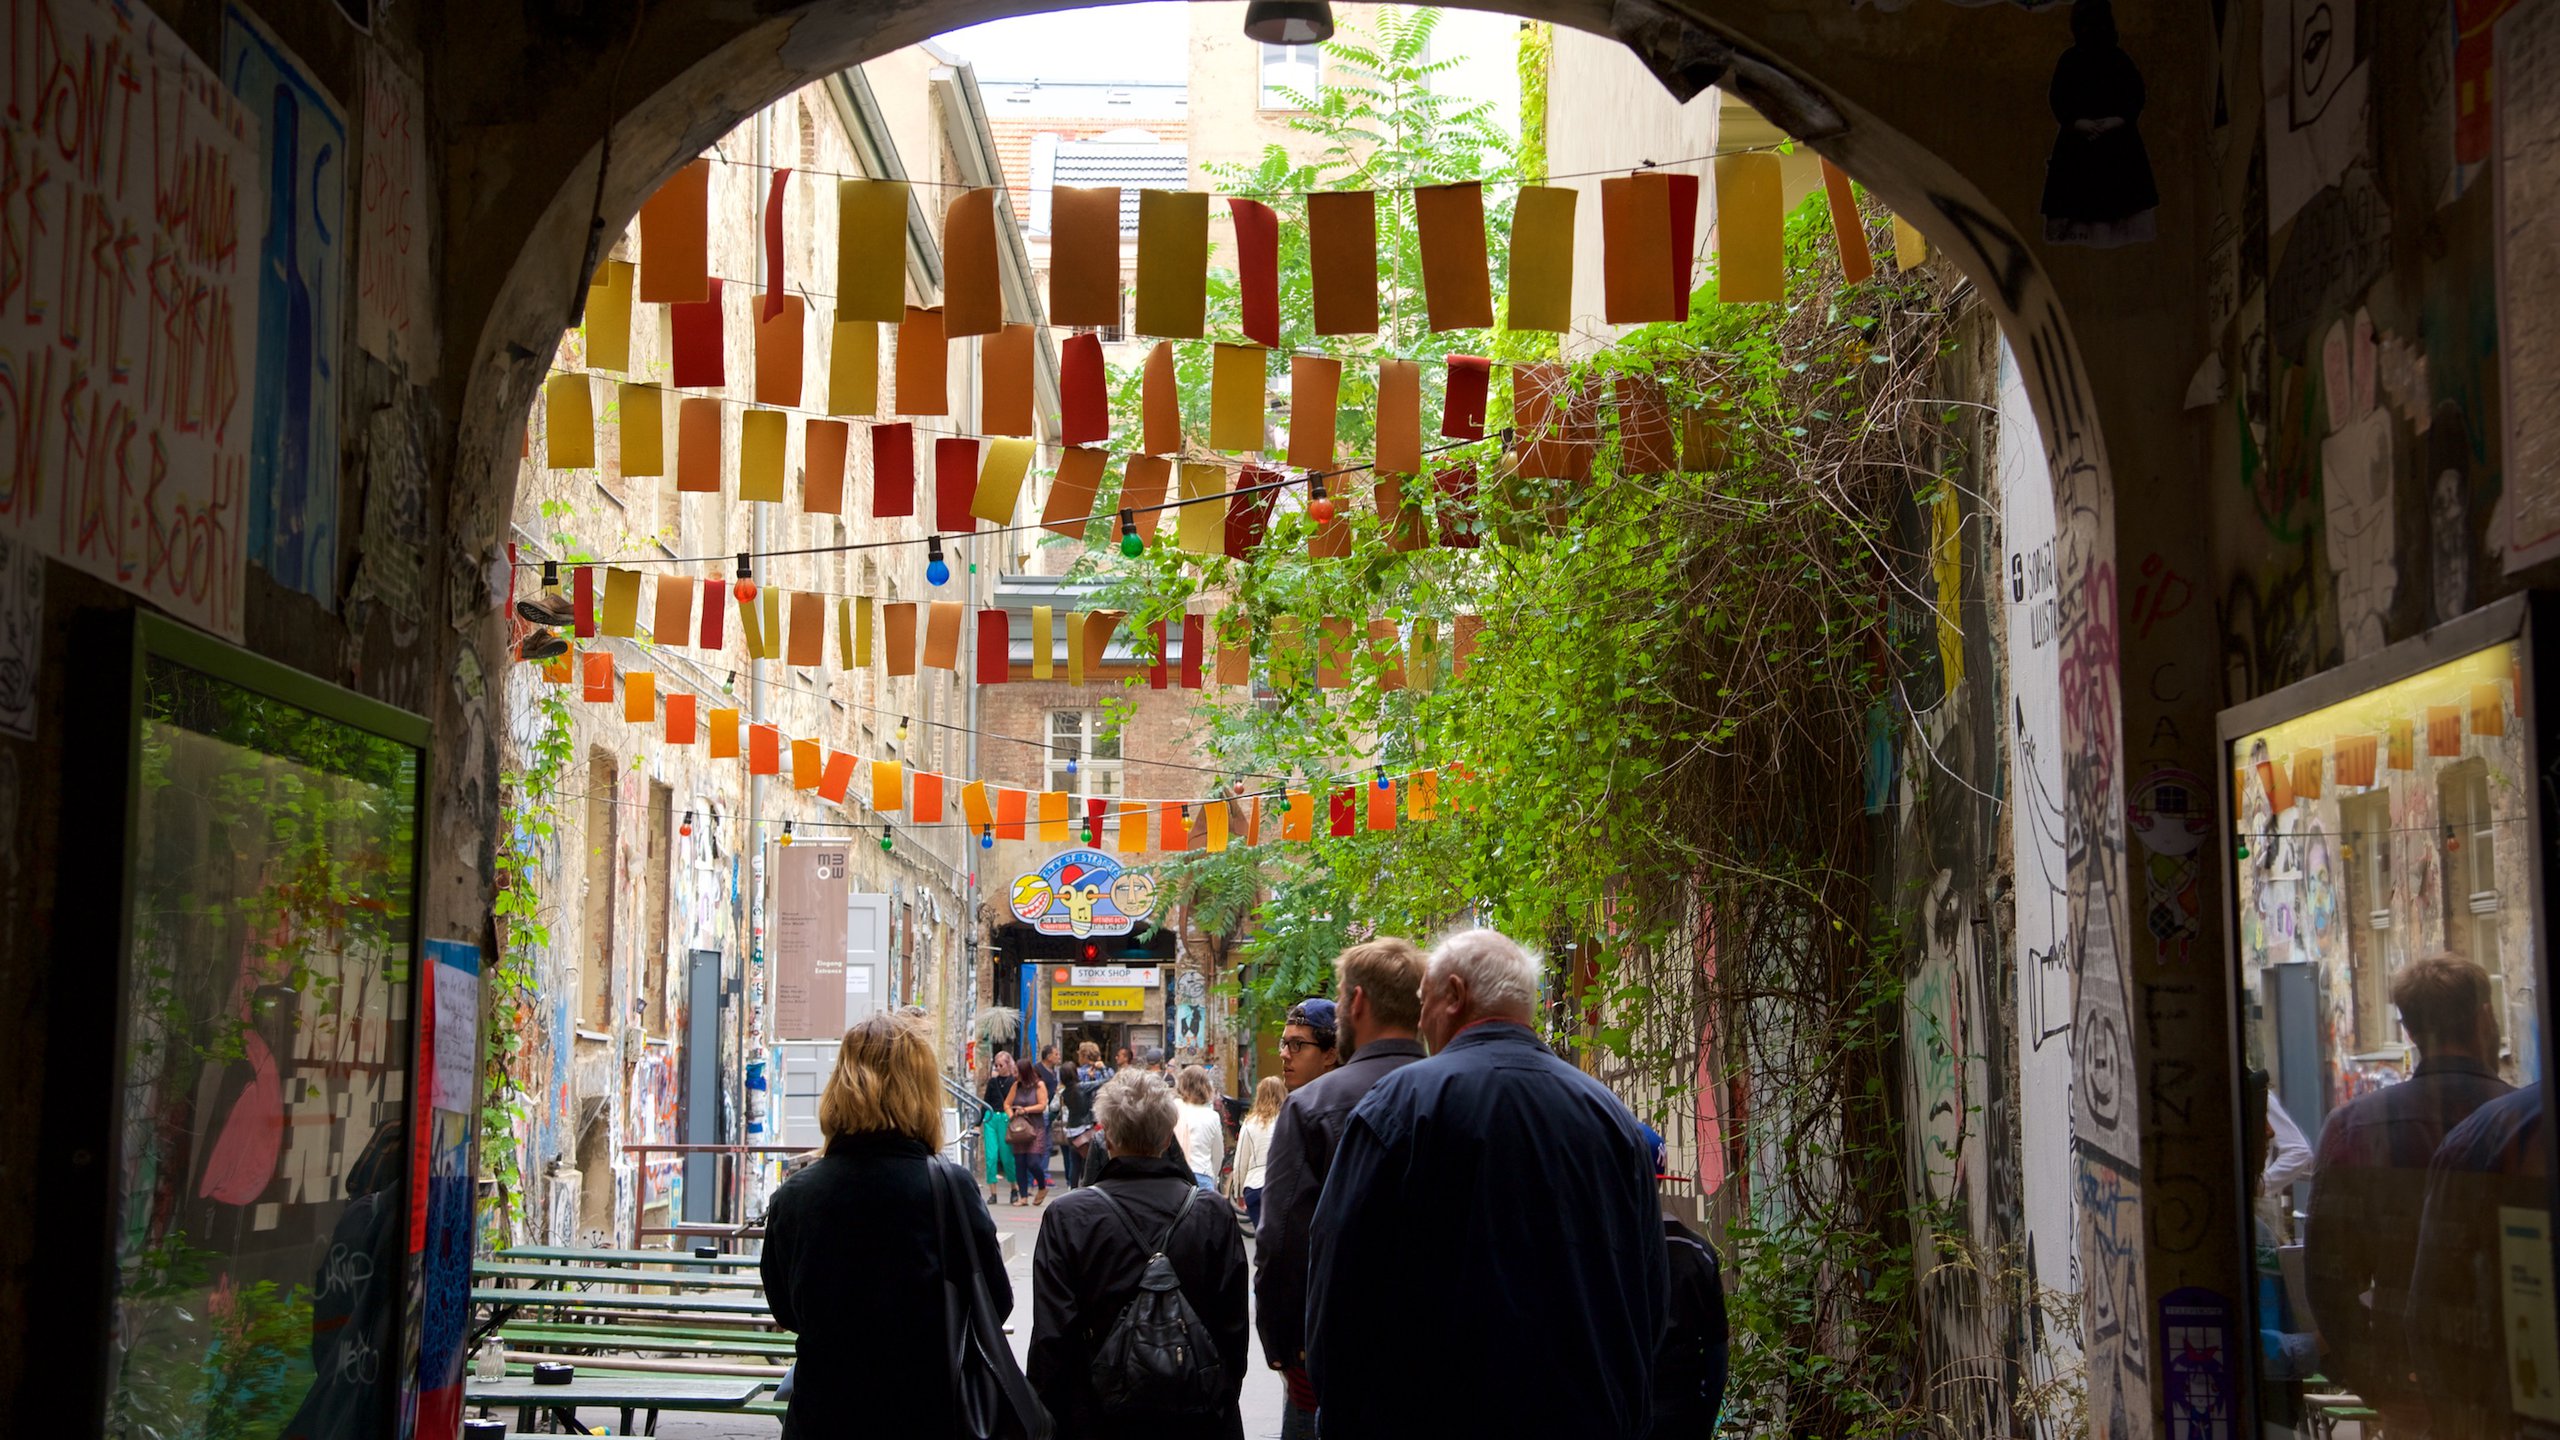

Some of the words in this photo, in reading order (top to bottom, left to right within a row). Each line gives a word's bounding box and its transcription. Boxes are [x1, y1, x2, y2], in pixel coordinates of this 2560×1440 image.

[1041, 859, 1062, 879] CITY
[1066, 854, 1077, 864] OF
[816, 960, 842, 968] Eingang
[815, 967, 842, 975] Entrance
[1078, 969, 1105, 977] STOKX
[1108, 969, 1131, 977] SHOP
